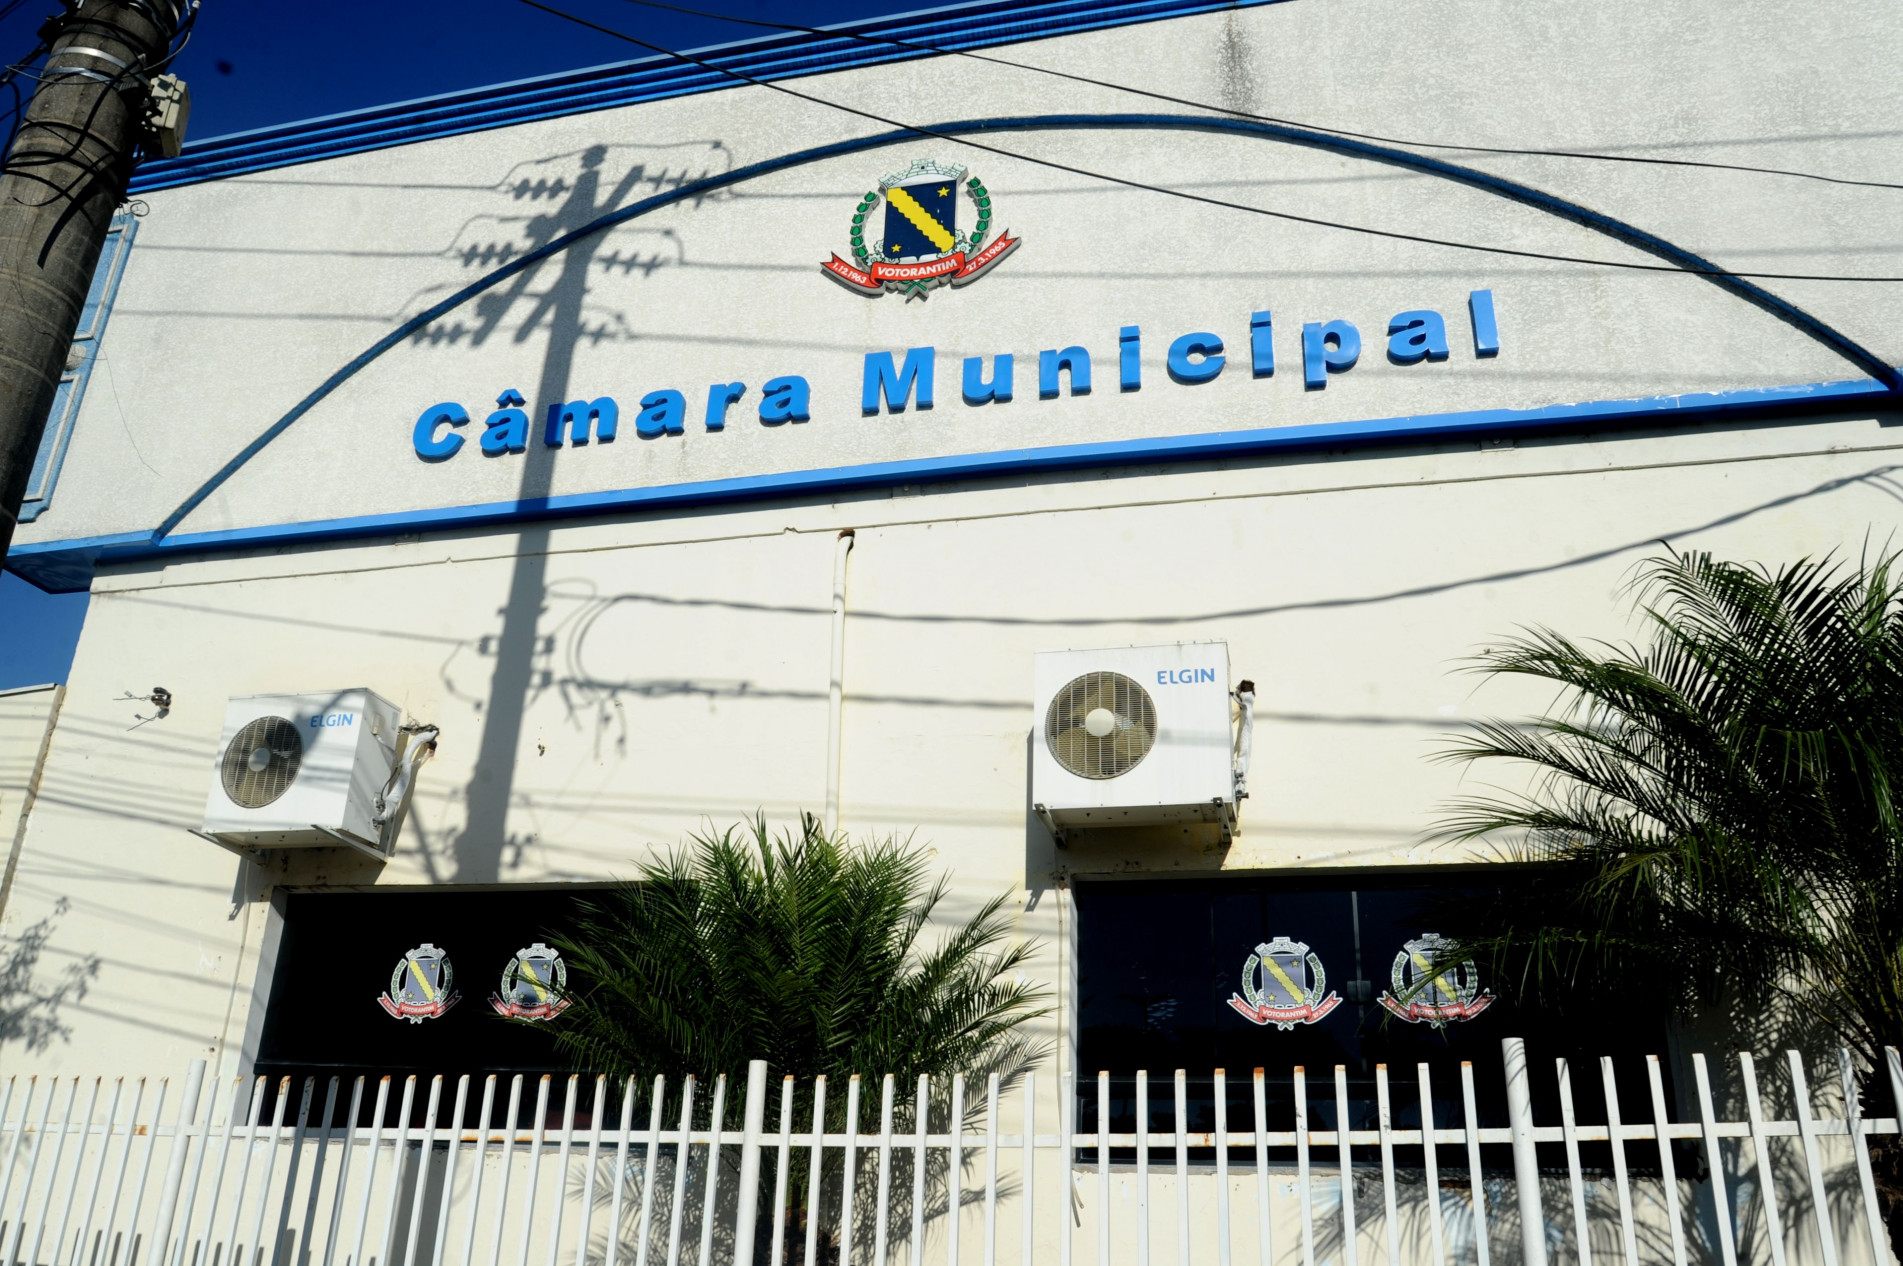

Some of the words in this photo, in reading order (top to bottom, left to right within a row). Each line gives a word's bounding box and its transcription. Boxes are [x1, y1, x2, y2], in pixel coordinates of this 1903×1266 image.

[831, 261, 868, 284] 1.12.1963
[877, 258, 958, 277] VOTORANTIM
[413, 375, 809, 461] Câmara
[861, 290, 1499, 415] Municipal
[1156, 667, 1216, 685] ELGIN
[309, 712, 353, 728] ELGIN
[1262, 1008, 1308, 1018] VOTORANTIM
